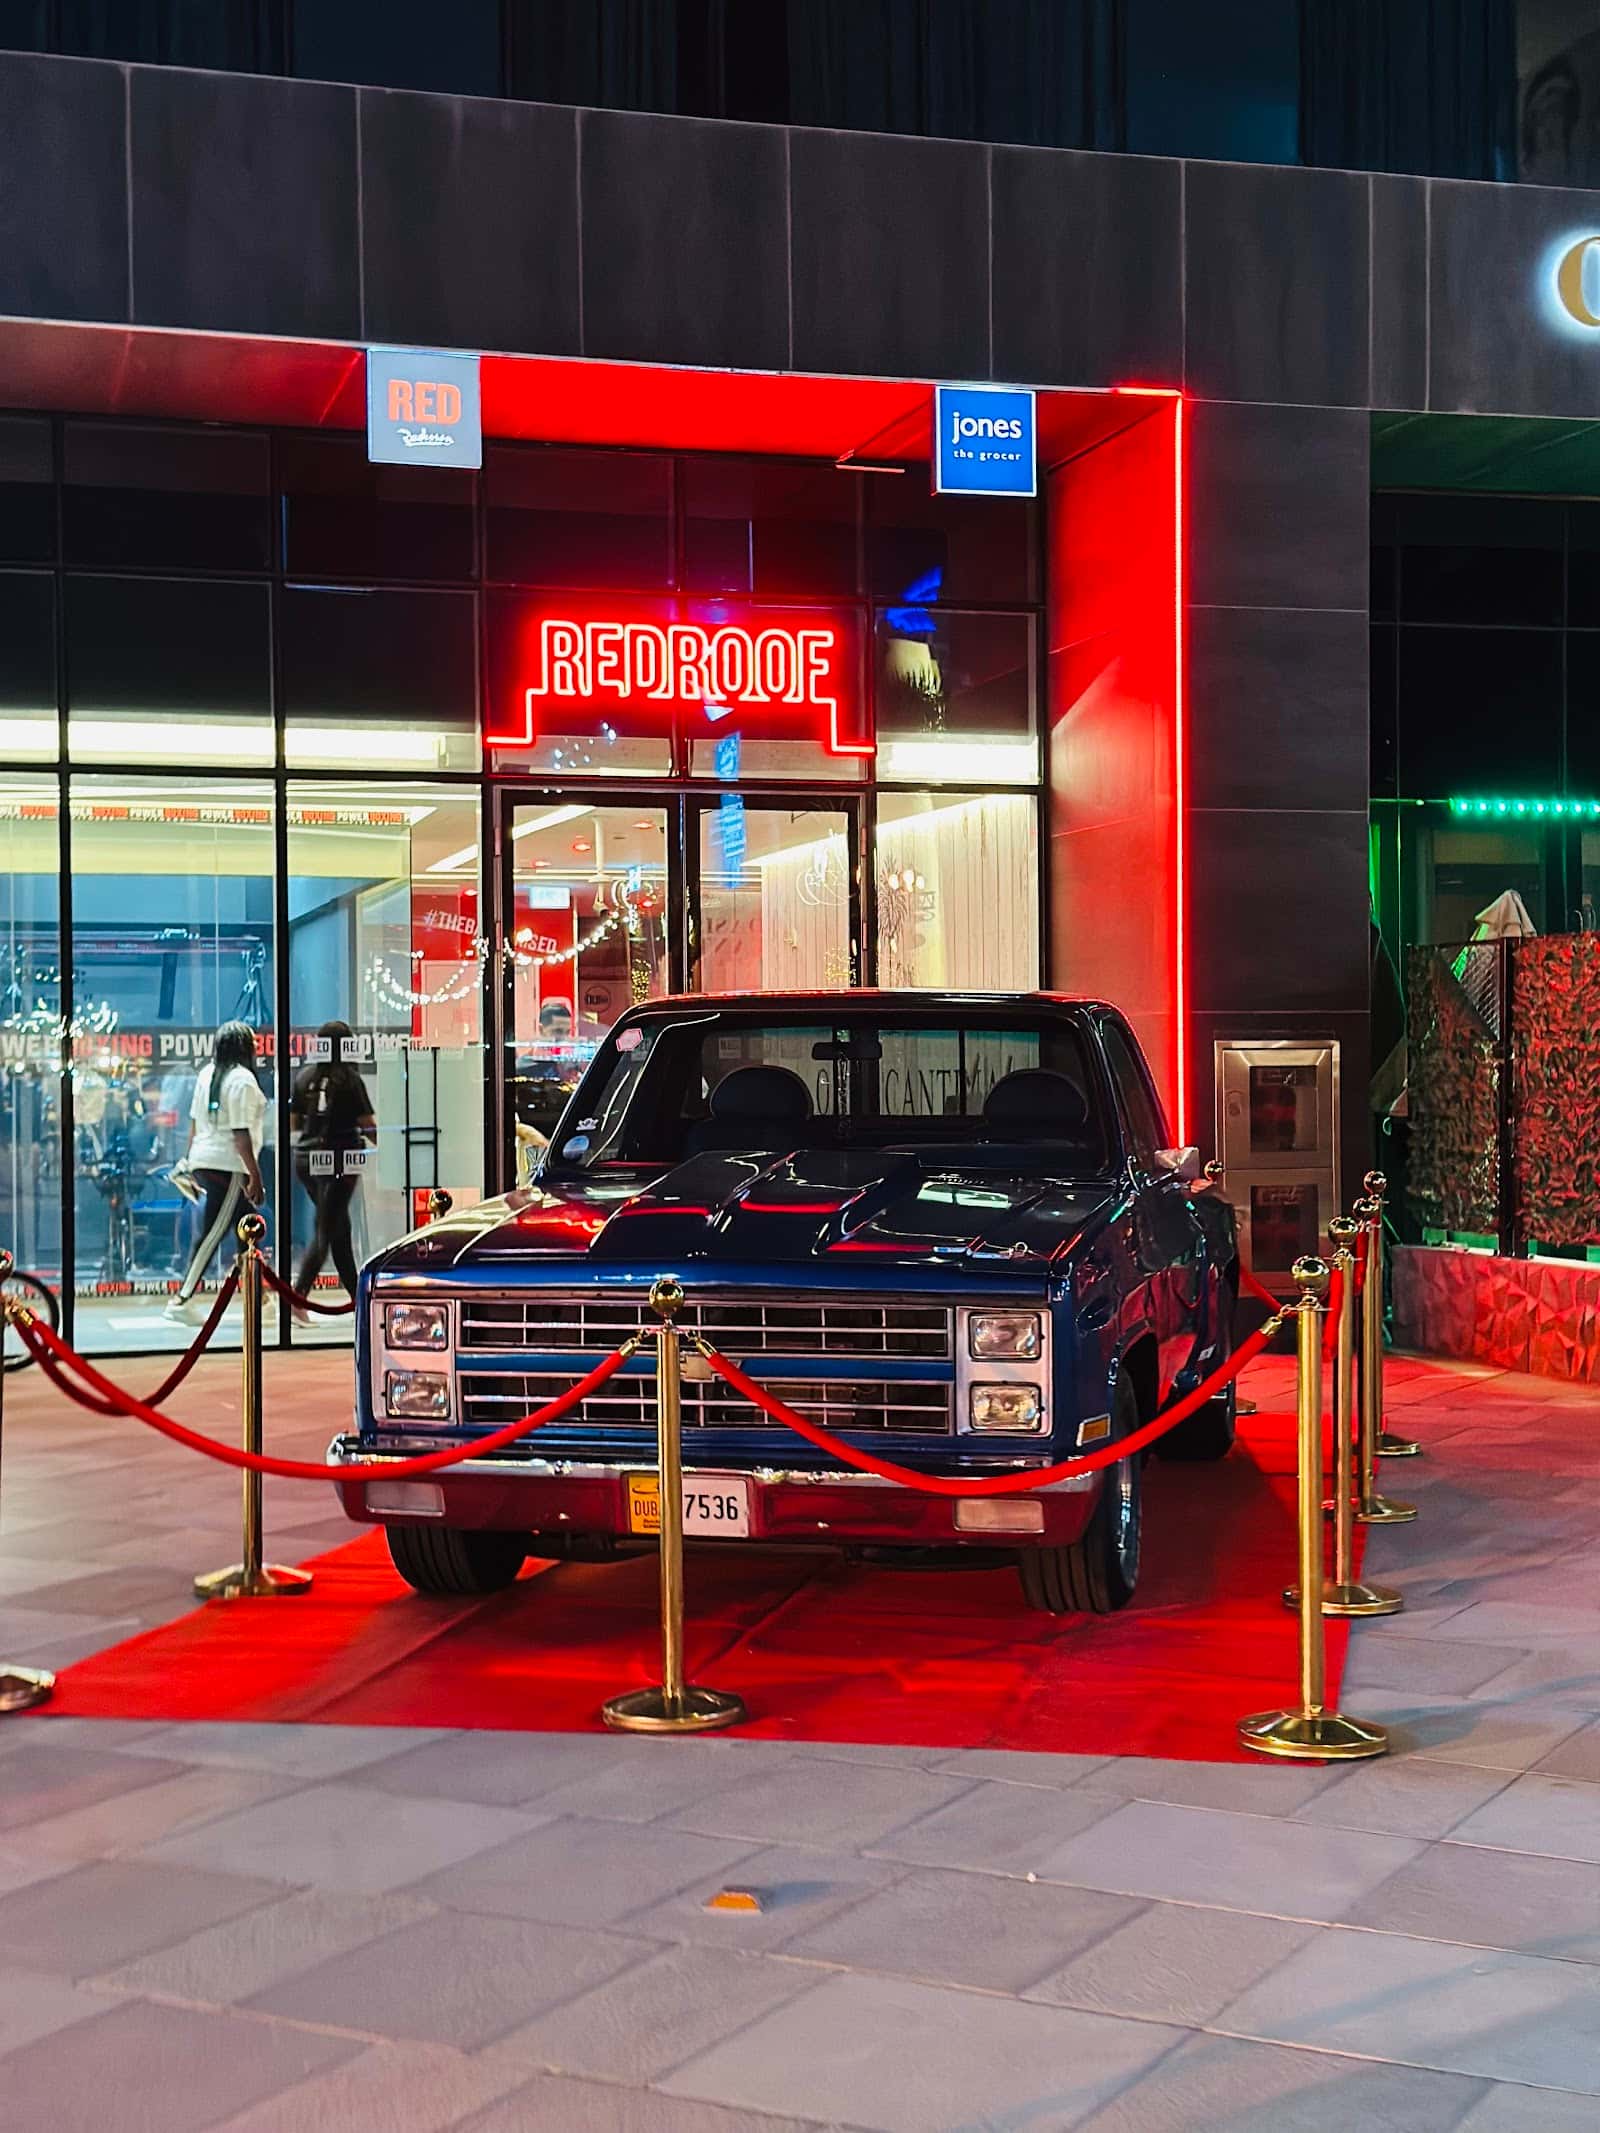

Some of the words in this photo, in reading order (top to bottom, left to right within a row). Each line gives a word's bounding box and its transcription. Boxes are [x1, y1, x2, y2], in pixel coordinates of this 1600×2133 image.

[387, 379, 461, 425] RED
[952, 411, 1022, 444] jones
[953, 449, 974, 459] the
[979, 451, 1021, 461] grocer
[541, 620, 835, 703] REDROOF
[312, 1154, 332, 1167] RED
[346, 1153, 366, 1166] RED
[684, 1494, 738, 1520] 7536
